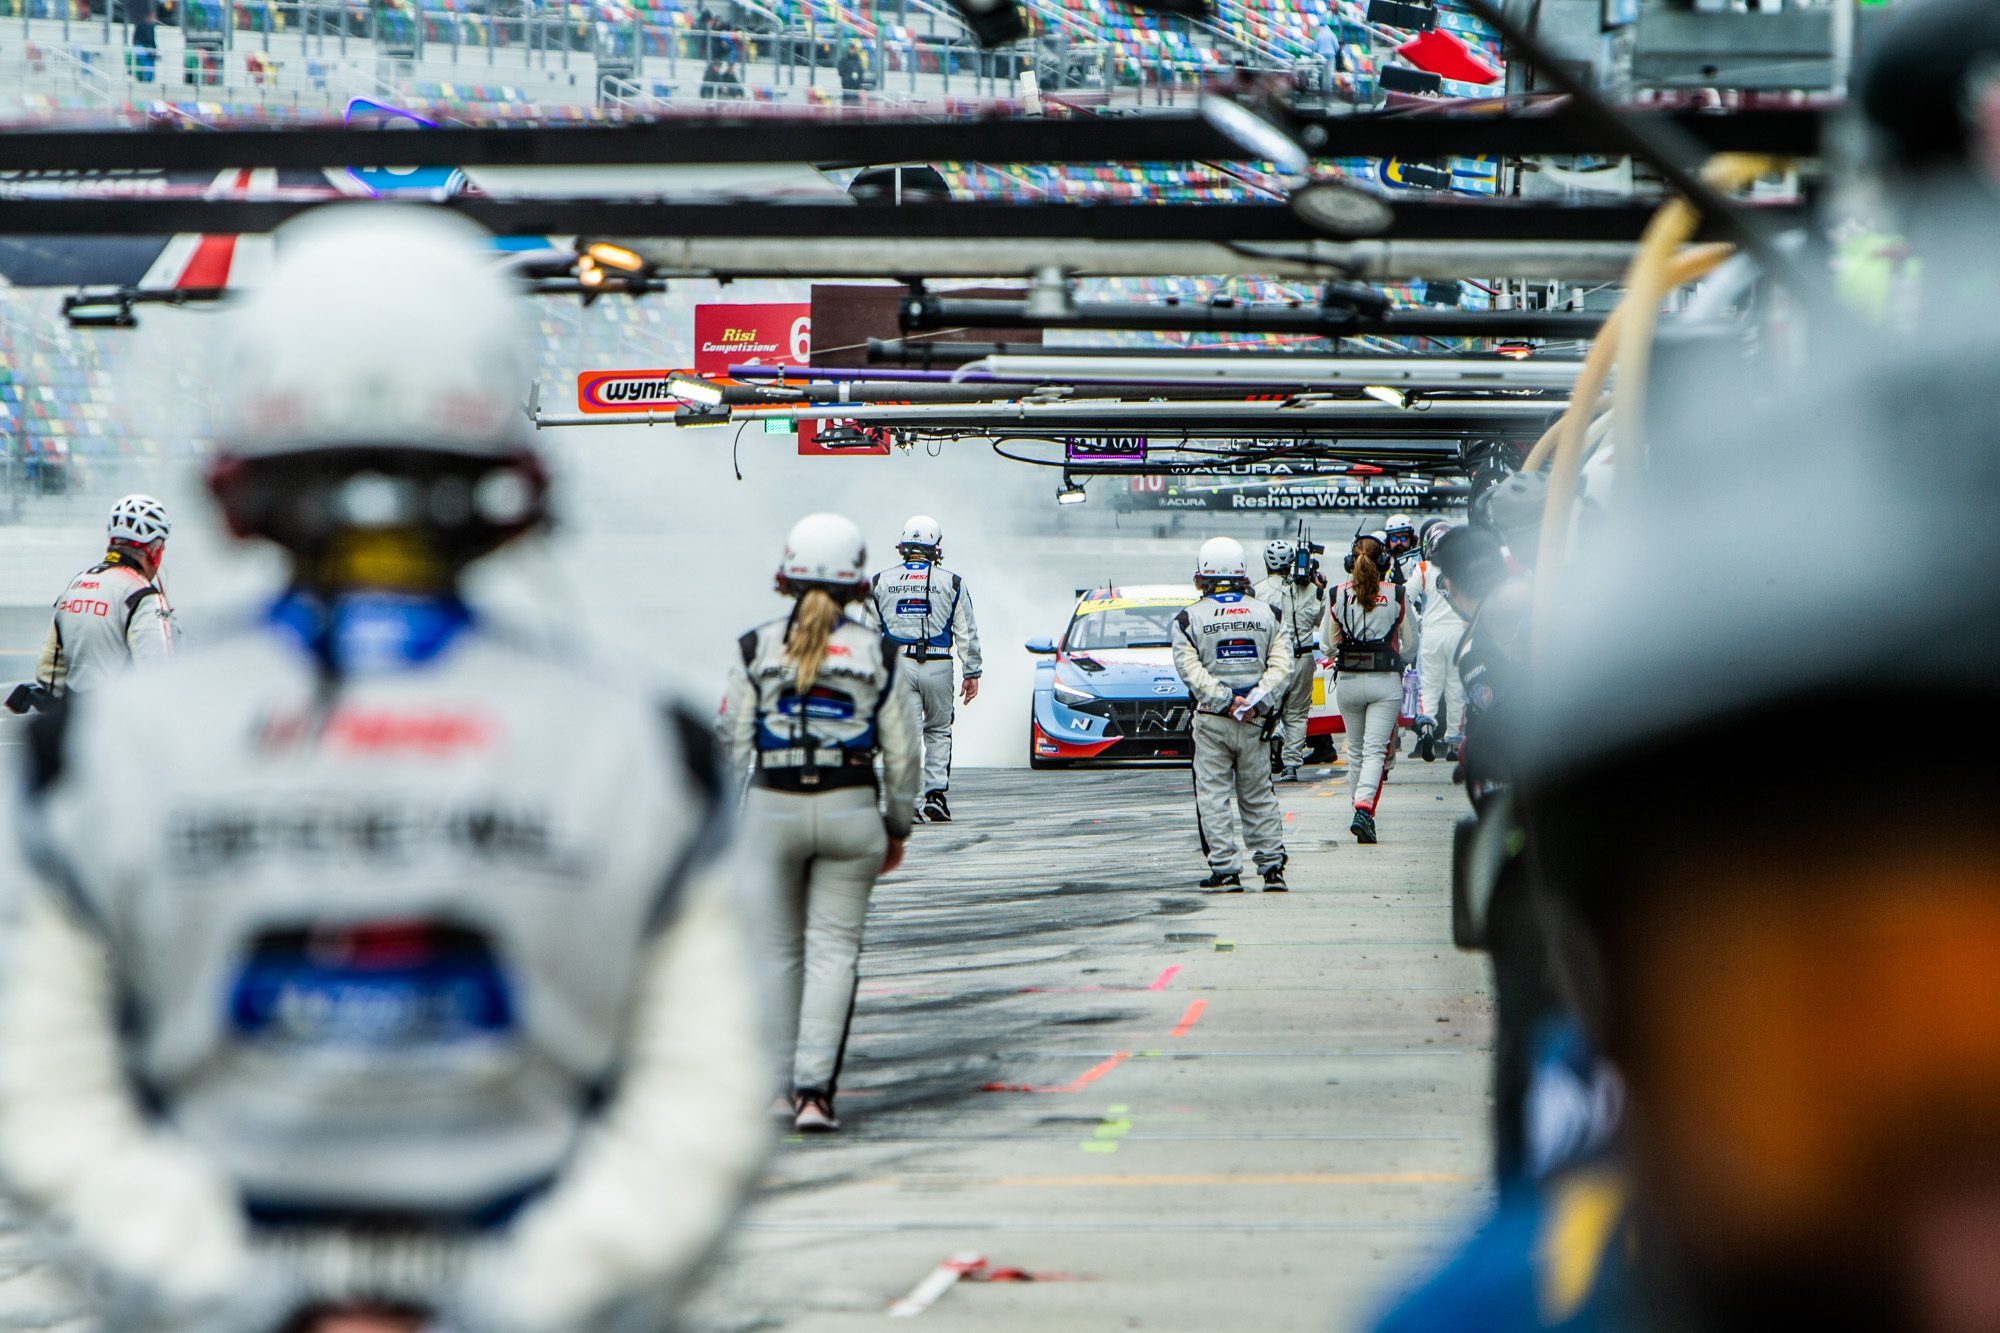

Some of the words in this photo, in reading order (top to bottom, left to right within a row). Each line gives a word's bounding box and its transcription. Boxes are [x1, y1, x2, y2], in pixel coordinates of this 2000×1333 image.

[722, 328, 757, 342] Risi
[606, 382, 669, 401] wynn
[1192, 464, 1294, 475] ACURA
[1166, 497, 1207, 507] ACURA
[1232, 493, 1420, 509] ReshapeWork.com
[888, 584, 940, 595] OFFICIAL
[1226, 607, 1252, 616] IMSA
[1203, 621, 1267, 635] OFFICIAL
[1070, 717, 1094, 731] N
